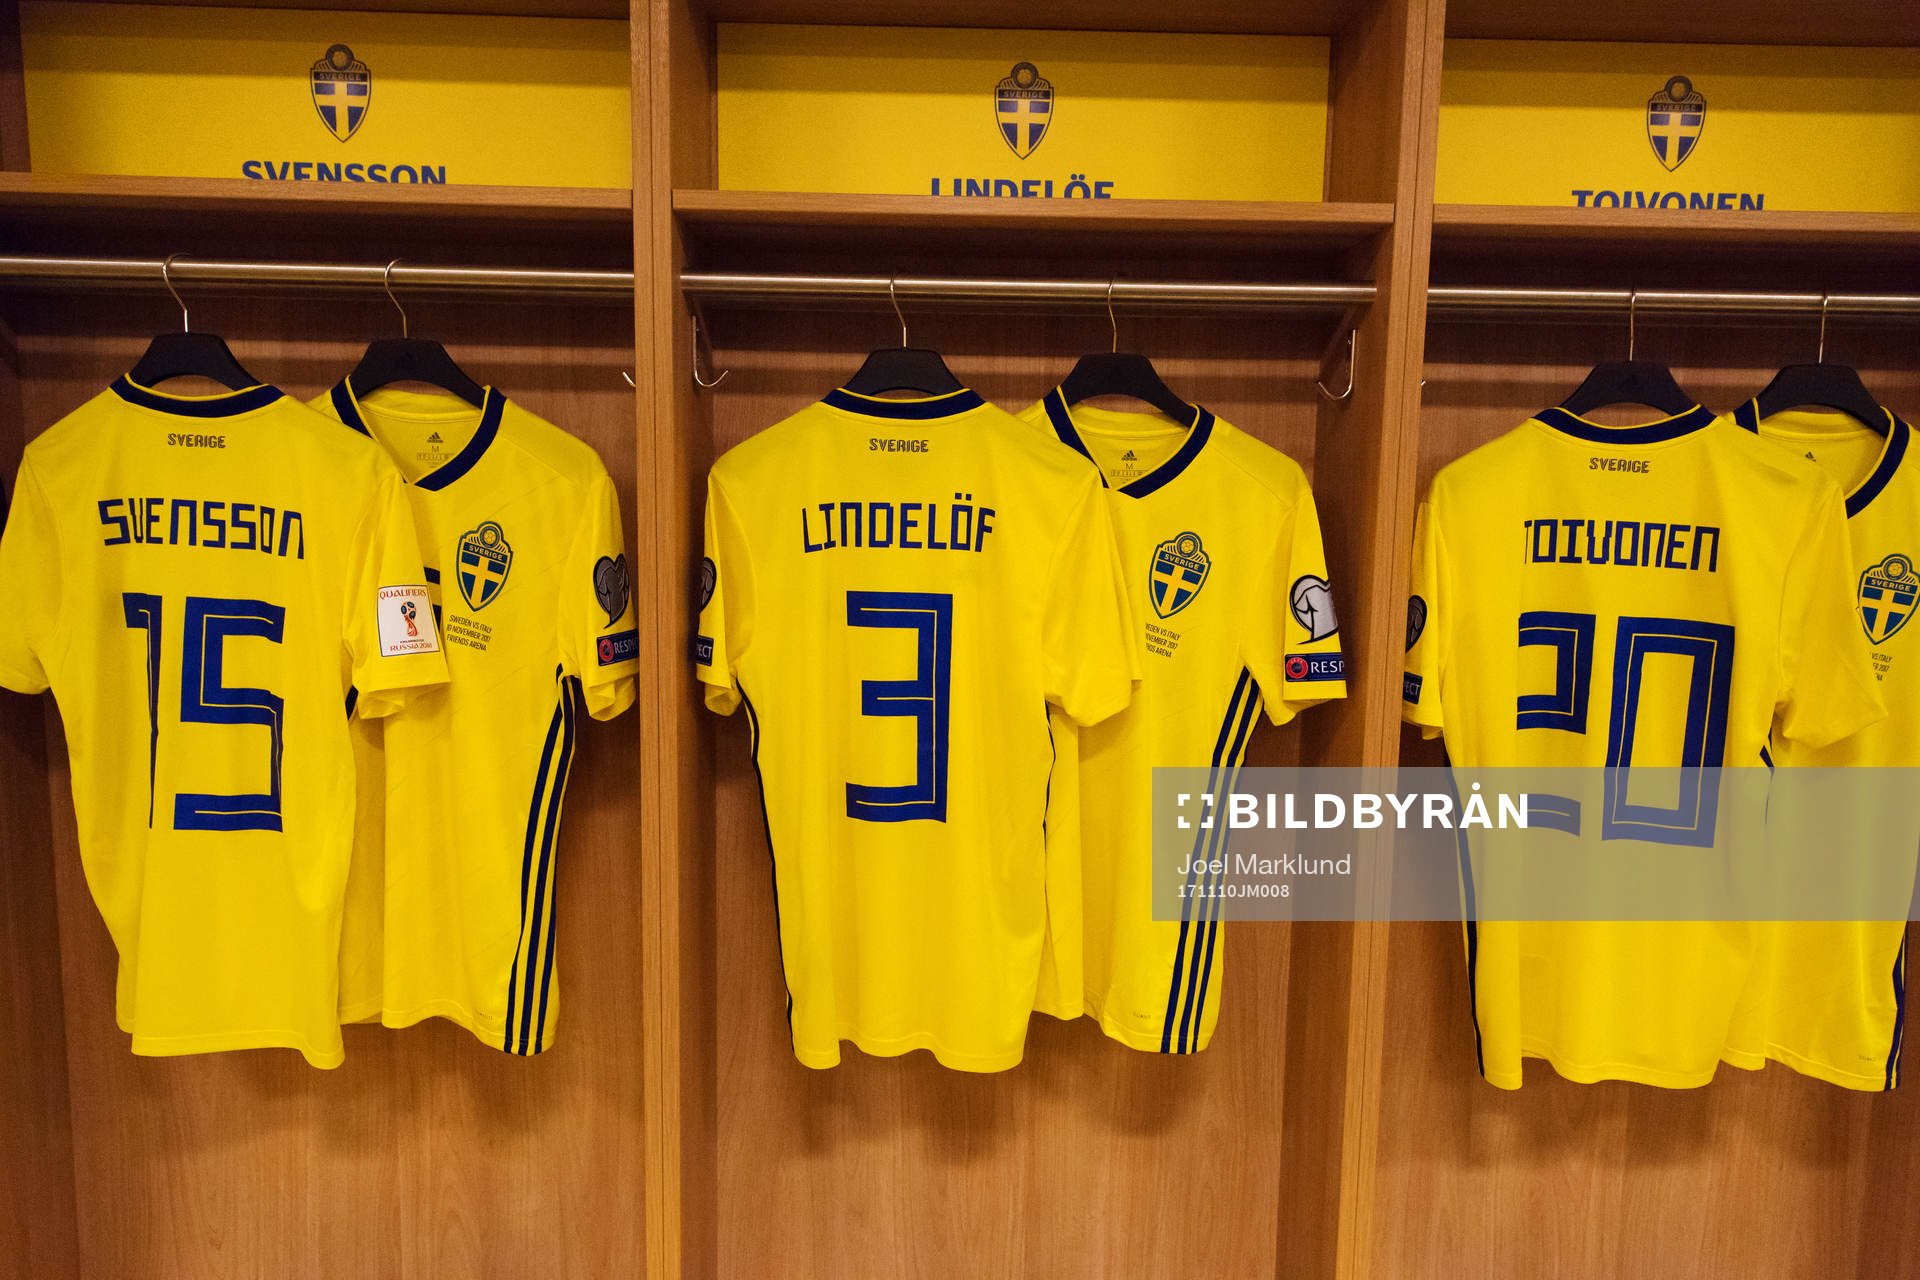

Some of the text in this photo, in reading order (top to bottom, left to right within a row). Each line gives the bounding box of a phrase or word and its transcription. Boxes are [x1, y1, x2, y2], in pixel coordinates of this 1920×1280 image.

[319, 73, 362, 82] SVERIGE
[1003, 90, 1044, 99] SVERIGE
[242, 160, 446, 185] SVENSSON
[167, 433, 226, 449] SVERIGE
[868, 438, 929, 453] SVERIGE
[1588, 457, 1651, 474] SVERIGE
[98, 497, 304, 560] SVENSSON
[802, 492, 996, 553] LINDELÖF
[468, 544, 503, 561] SVERIGE
[1164, 553, 1200, 571] SVERIGE
[1871, 579, 1911, 592] SVERIGE
[379, 588, 427, 600] QUALIFIERS
[449, 614, 472, 627] SWEDEN
[472, 621, 480, 630] VS
[452, 625, 481, 640] NOVEMBER
[1160, 628, 1167, 637] VS
[1167, 630, 1181, 641] ITALY
[447, 633, 487, 651] FRIENDS ARENA
[1155, 647, 1172, 658] ARENA
[122, 592, 286, 833] 15
[846, 590, 953, 824] 3
